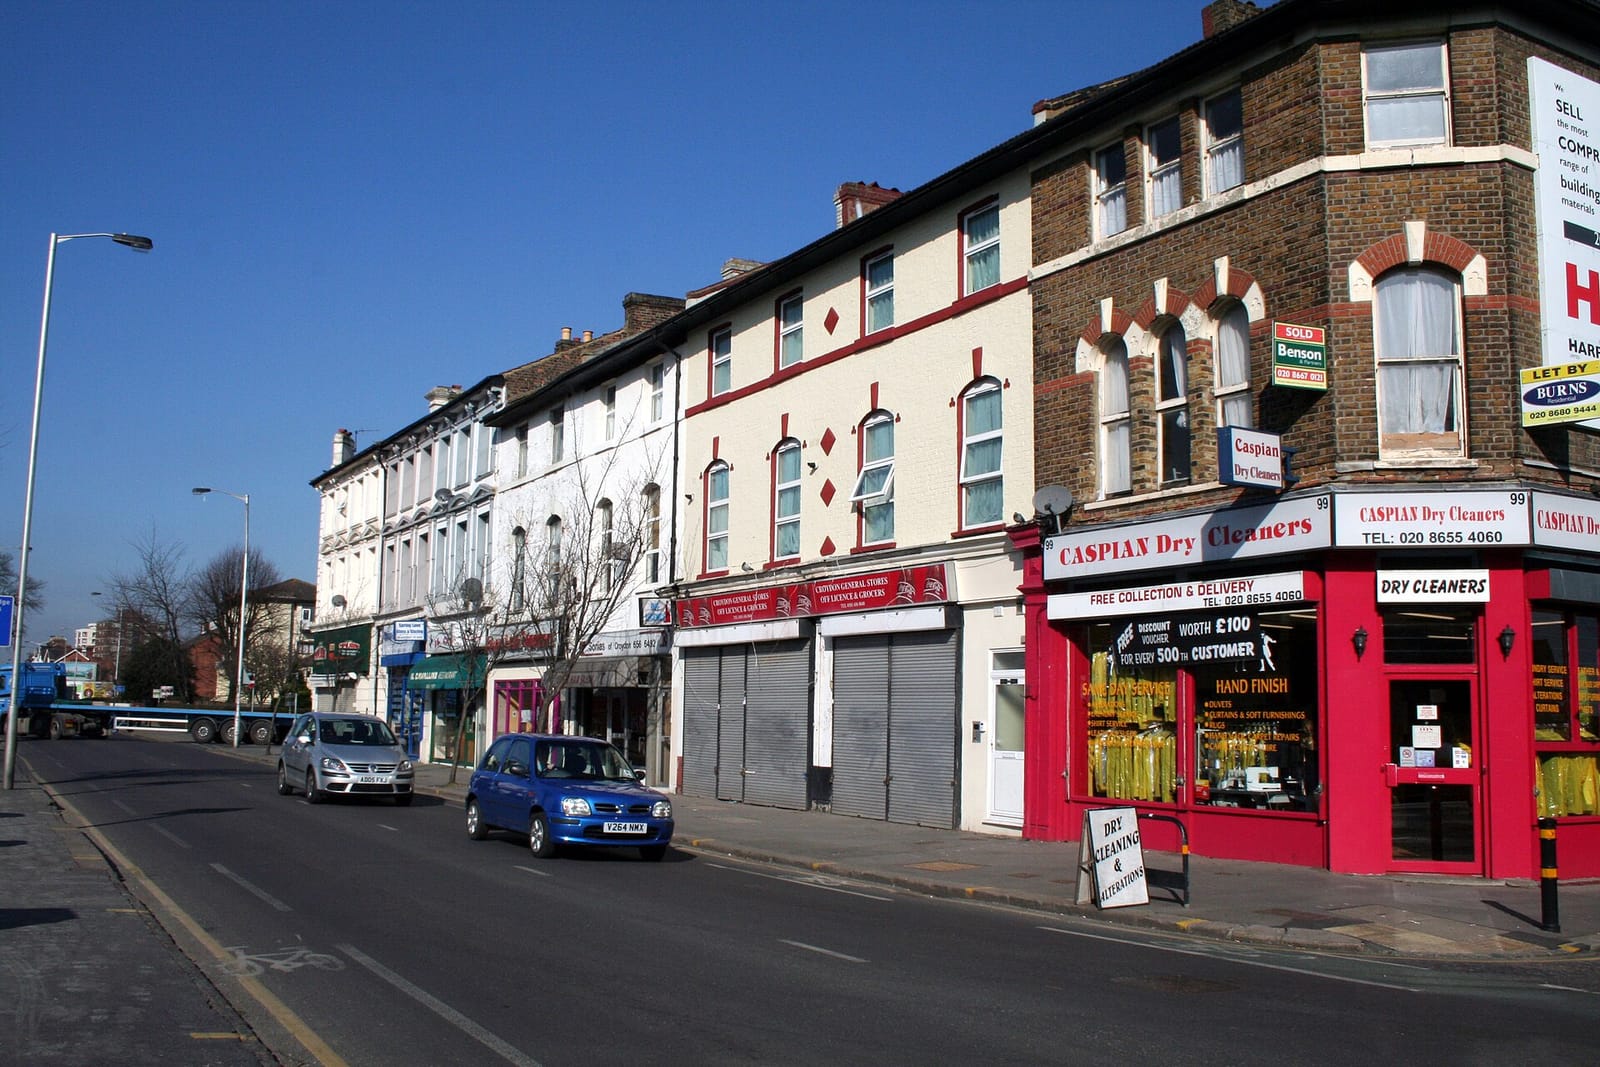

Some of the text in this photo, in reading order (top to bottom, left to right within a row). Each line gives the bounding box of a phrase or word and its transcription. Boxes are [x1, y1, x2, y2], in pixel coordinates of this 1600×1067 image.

[1556, 99, 1583, 121] SELL
[1557, 119, 1588, 137] the most
[1560, 158, 1589, 174] range of
[1561, 197, 1595, 216] materials
[1286, 327, 1313, 339] SOLD
[1278, 343, 1322, 361] Benson
[1277, 370, 1290, 378] 020
[1310, 373, 1323, 381] 0121
[1533, 364, 1587, 380] LET BY
[1537, 382, 1587, 400] BURNS
[1530, 411, 1546, 419] 020
[1548, 408, 1571, 417] 8680
[1573, 405, 1597, 414] 9444
[1235, 438, 1279, 457] Caspian
[1235, 464, 1280, 481] Dry Cleaners
[1317, 497, 1329, 510] 99
[1510, 492, 1525, 505] 99
[1360, 505, 1505, 525] CASPIAN Dry Cleaners
[1537, 510, 1584, 534] CASPIAN
[1045, 540, 1054, 550] 99
[1059, 518, 1312, 565] CASPIAN Dry Cleaners
[1362, 531, 1503, 544] TEL: 020 8655 4060
[815, 577, 888, 594] CROYDON GENERAL STORES
[1090, 580, 1254, 605] FREE COLLECTION & DELIVERY
[1381, 579, 1486, 594] DRY CLEANERS
[713, 591, 769, 607] CROYDON GENERAL STORES
[831, 592, 853, 603] LICENCE
[859, 589, 886, 599] GROCERS
[1203, 590, 1302, 607] TEL: 020 8655 4060
[747, 602, 767, 612] GROCERS
[1138, 616, 1250, 637] DISCOUNT WORTH £100
[1117, 622, 1134, 653] FREE
[1142, 633, 1169, 645] VOUCHER
[614, 641, 631, 652] Croydon
[1121, 652, 1134, 665] FOR
[1135, 651, 1155, 664] EVERY
[1192, 642, 1255, 661] CUSTOMER
[1547, 665, 1567, 675] SERVICE
[1109, 683, 1128, 695] DAY
[1132, 681, 1170, 696] SERVICE
[1216, 678, 1288, 694] HAND FINISH
[1543, 679, 1564, 688] SERVICE
[1209, 711, 1238, 719] CURTAINS
[1263, 711, 1305, 719] FURNISHINGS
[1273, 733, 1300, 741] REPAIRS
[607, 823, 627, 831] V264
[1104, 816, 1123, 837] DRY
[1095, 830, 1139, 864] CLEANING
[1113, 858, 1122, 872] &
[1100, 866, 1144, 902] ALTERATIONS
